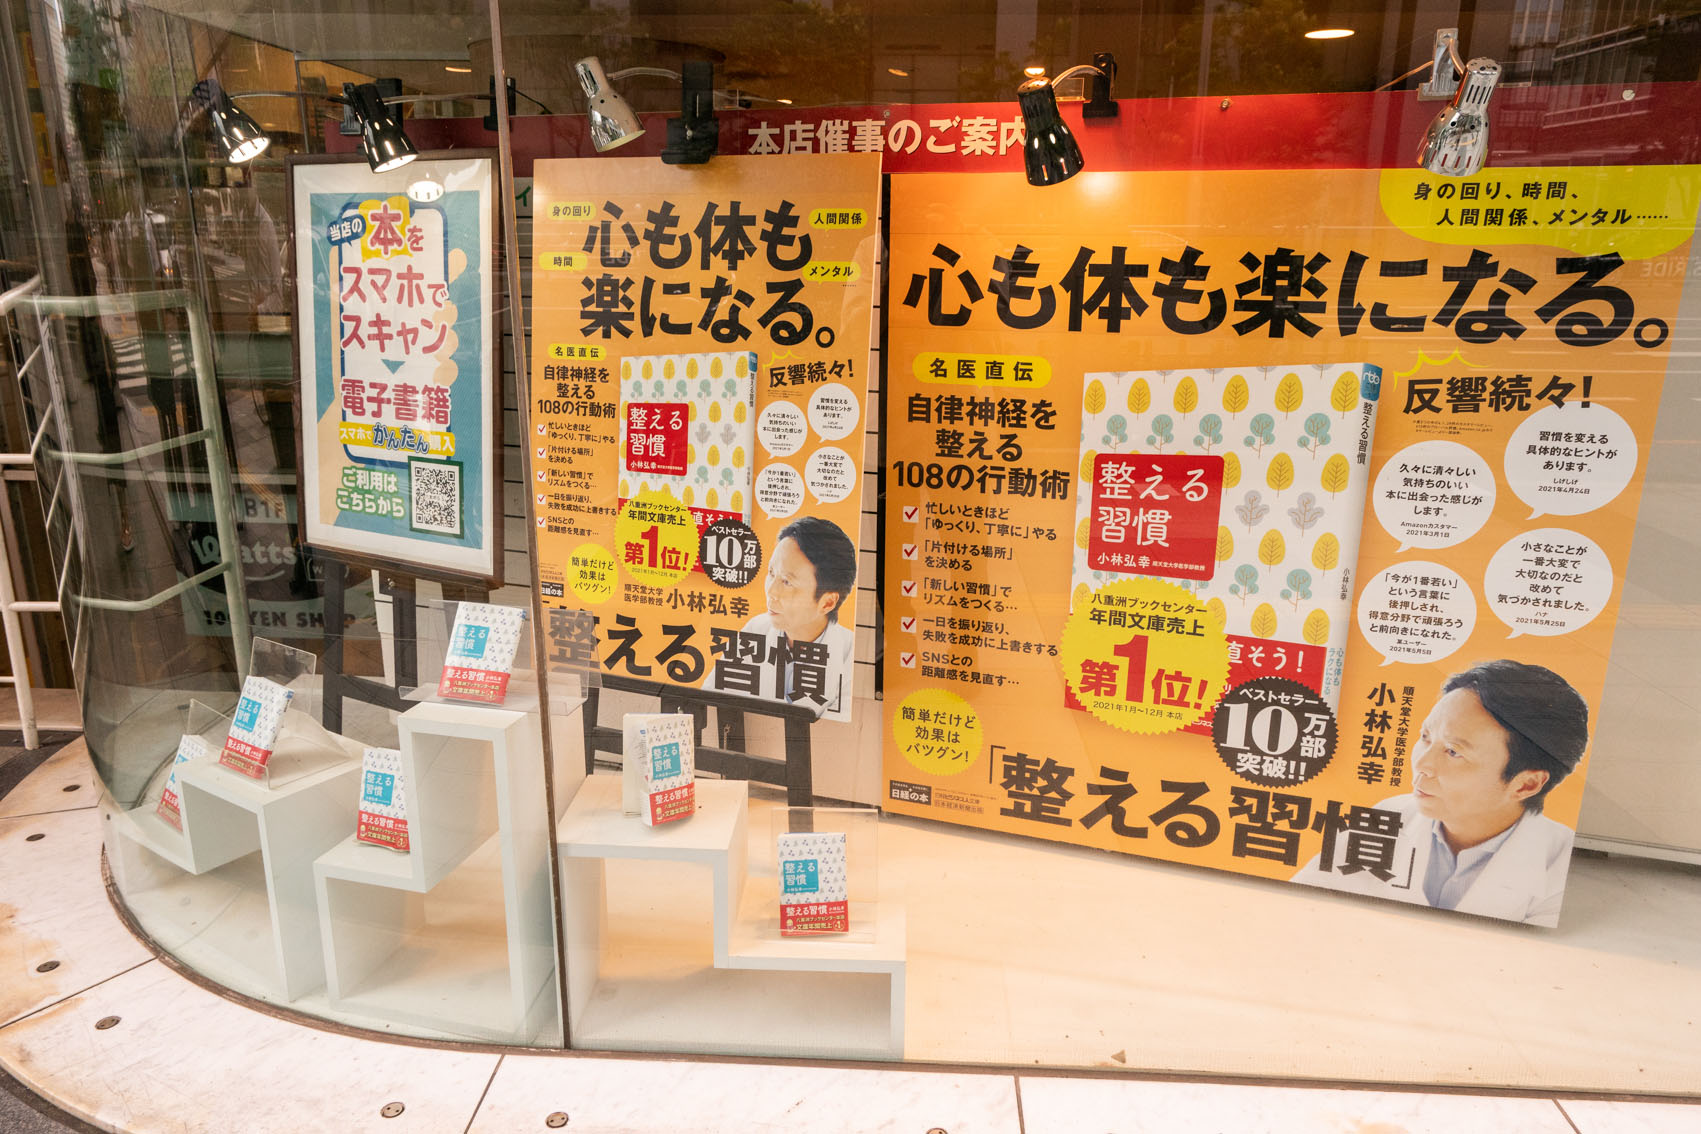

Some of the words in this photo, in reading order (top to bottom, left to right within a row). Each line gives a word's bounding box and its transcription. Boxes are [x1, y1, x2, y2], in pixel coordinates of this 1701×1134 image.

[748, 115, 1026, 156] 本店催事のご案内
[1414, 181, 1579, 200] 身の回り、時間、
[552, 205, 591, 217] 身の回り
[814, 212, 862, 225] 人間関係
[330, 218, 363, 241] 当店の
[369, 203, 425, 255] 本を
[582, 200, 813, 271] 心も体も
[553, 256, 573, 267] 時間
[809, 265, 854, 277] メンタル
[341, 265, 448, 308] スマホで
[903, 243, 1669, 348] 心も体も楽になる。
[580, 273, 835, 348] 楽になる。
[341, 313, 448, 355] スキャン
[555, 346, 599, 358] 名医直伝
[544, 364, 610, 383] 自律神経を
[770, 359, 854, 388] 反響続々!
[929, 358, 1033, 382] 名医直伝
[556, 383, 596, 400] 整える
[1403, 374, 1593, 415] 反響続々!
[341, 378, 450, 425] 電子書籍
[537, 399, 616, 419] 108の行動術
[630, 407, 683, 431] 整える
[907, 393, 1057, 430] 自律神経を
[548, 422, 592, 432] 忙しいときほど
[1357, 402, 1374, 465] 整える習慣
[548, 431, 616, 444] 「ゆっくり、丁寧に」やる
[630, 433, 666, 457] 習慣
[935, 428, 1023, 462] 整える
[1538, 430, 1609, 445] 習慣を変える
[548, 445, 594, 457] 「片付ける場所」
[548, 455, 574, 464] を決める
[1526, 444, 1617, 460] 具体的なヒントが
[547, 468, 594, 480] 「新しい習慣」で
[1399, 463, 1476, 477] 久々に清々しい
[1542, 460, 1593, 473] あります。
[342, 468, 398, 493] ご利用は
[893, 460, 1070, 500] 108の行動術
[1099, 461, 1209, 502] 整える
[1402, 477, 1469, 490] 気持ちのいい
[547, 493, 592, 504] 一日を振り返り、
[1385, 490, 1483, 506] 本に出会った感じが
[1538, 485, 1591, 495] 2021年4月24日
[336, 489, 405, 517] こちらから
[547, 502, 617, 516] 失敗を成功に上書きする
[628, 500, 687, 512] 八重洲ブックセンター
[925, 501, 1010, 520] 忙しいときほど
[1413, 505, 1447, 518] します。
[547, 516, 575, 525] SNSとの
[628, 509, 687, 527] 年間文庫売上
[1098, 506, 1172, 547] 習慣
[1400, 521, 1458, 531] Amazonカスタマー
[711, 526, 752, 536] ベストセラー
[925, 517, 1057, 541] 「ゆっくり、丁寧に」やる
[1405, 529, 1450, 538] 2021年3月1日
[624, 525, 690, 571] 第1位!
[924, 539, 1013, 560] 「片付ける場所」
[1521, 541, 1587, 556] 小さなことが
[572, 556, 615, 571] 簡単だけど
[924, 556, 973, 571] を決める
[1097, 552, 1150, 568] 小林弘幸
[1522, 556, 1581, 569] 一番大変で
[579, 570, 606, 581] 効果は
[712, 567, 748, 583] 突破!!
[1385, 572, 1459, 589] 「今が1番若い」
[1515, 568, 1583, 584] 大切なのだと
[574, 581, 611, 594] バツグン!
[624, 583, 664, 596] 順天堂大学
[923, 577, 1012, 598] 「新しい習慣」で
[1388, 586, 1450, 601] という言葉に
[1529, 583, 1564, 595] 改めて
[623, 593, 664, 606] 医学部教授
[666, 588, 750, 618] 小林弘幸
[1091, 593, 1208, 615] 八重洲ブックセンター
[1388, 599, 1444, 614] 後押しされ、
[1497, 594, 1590, 612] 気づかされました。
[296, 611, 356, 628] SHP
[922, 616, 1010, 635] 一日を振り返り、
[1089, 607, 1205, 637] 年間文庫売上
[1368, 610, 1463, 629] 得意分野で頑張ろう
[1515, 617, 1566, 627] 2021年5月25日
[1369, 623, 1457, 641] と前向きになれた。
[922, 629, 1058, 657] 失敗を成功に上書きする
[1389, 645, 1432, 655] 2021年5月5日
[921, 651, 973, 667] SNSとの
[1080, 634, 1208, 710] 第1位!
[1239, 686, 1319, 706] ベストセラー
[902, 705, 976, 730] 簡単だけど
[1166, 711, 1183, 721] 本店
[915, 725, 960, 744] 効果は
[1218, 702, 1329, 759] 10万部
[1357, 682, 1396, 785] 小林弘幸
[1389, 686, 1415, 787] 順天堂大学医学部教授
[906, 743, 969, 762] バツグン!
[1236, 752, 1306, 781] 突破!!
[891, 788, 929, 802] 日経の本
[989, 744, 1416, 889] 「整える習慣」
